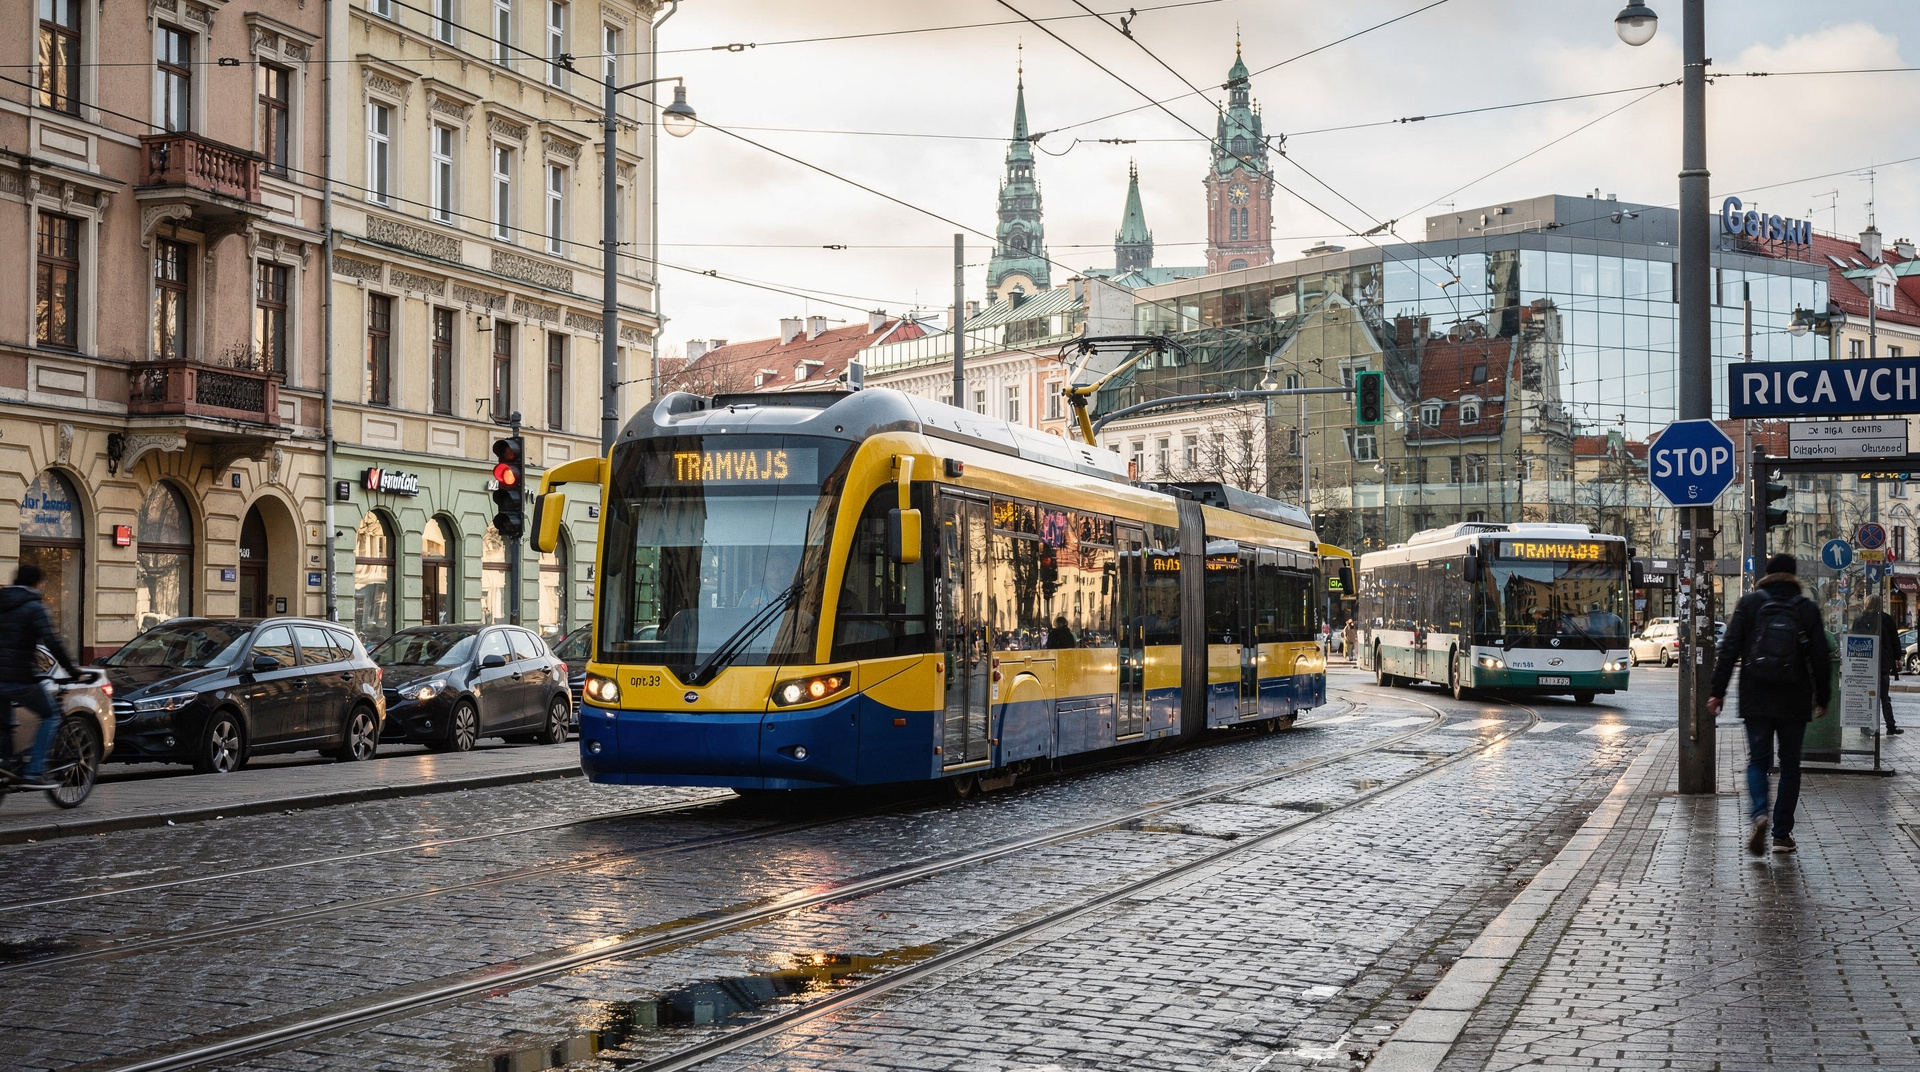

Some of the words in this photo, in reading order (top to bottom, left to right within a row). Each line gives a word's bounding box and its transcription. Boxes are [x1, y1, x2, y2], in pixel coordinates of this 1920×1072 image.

[1743, 370, 1837, 405] RICA
[1843, 367, 1917, 402] VCH
[674, 450, 789, 481] TRAMVAJS
[1655, 446, 1729, 478] STOP
